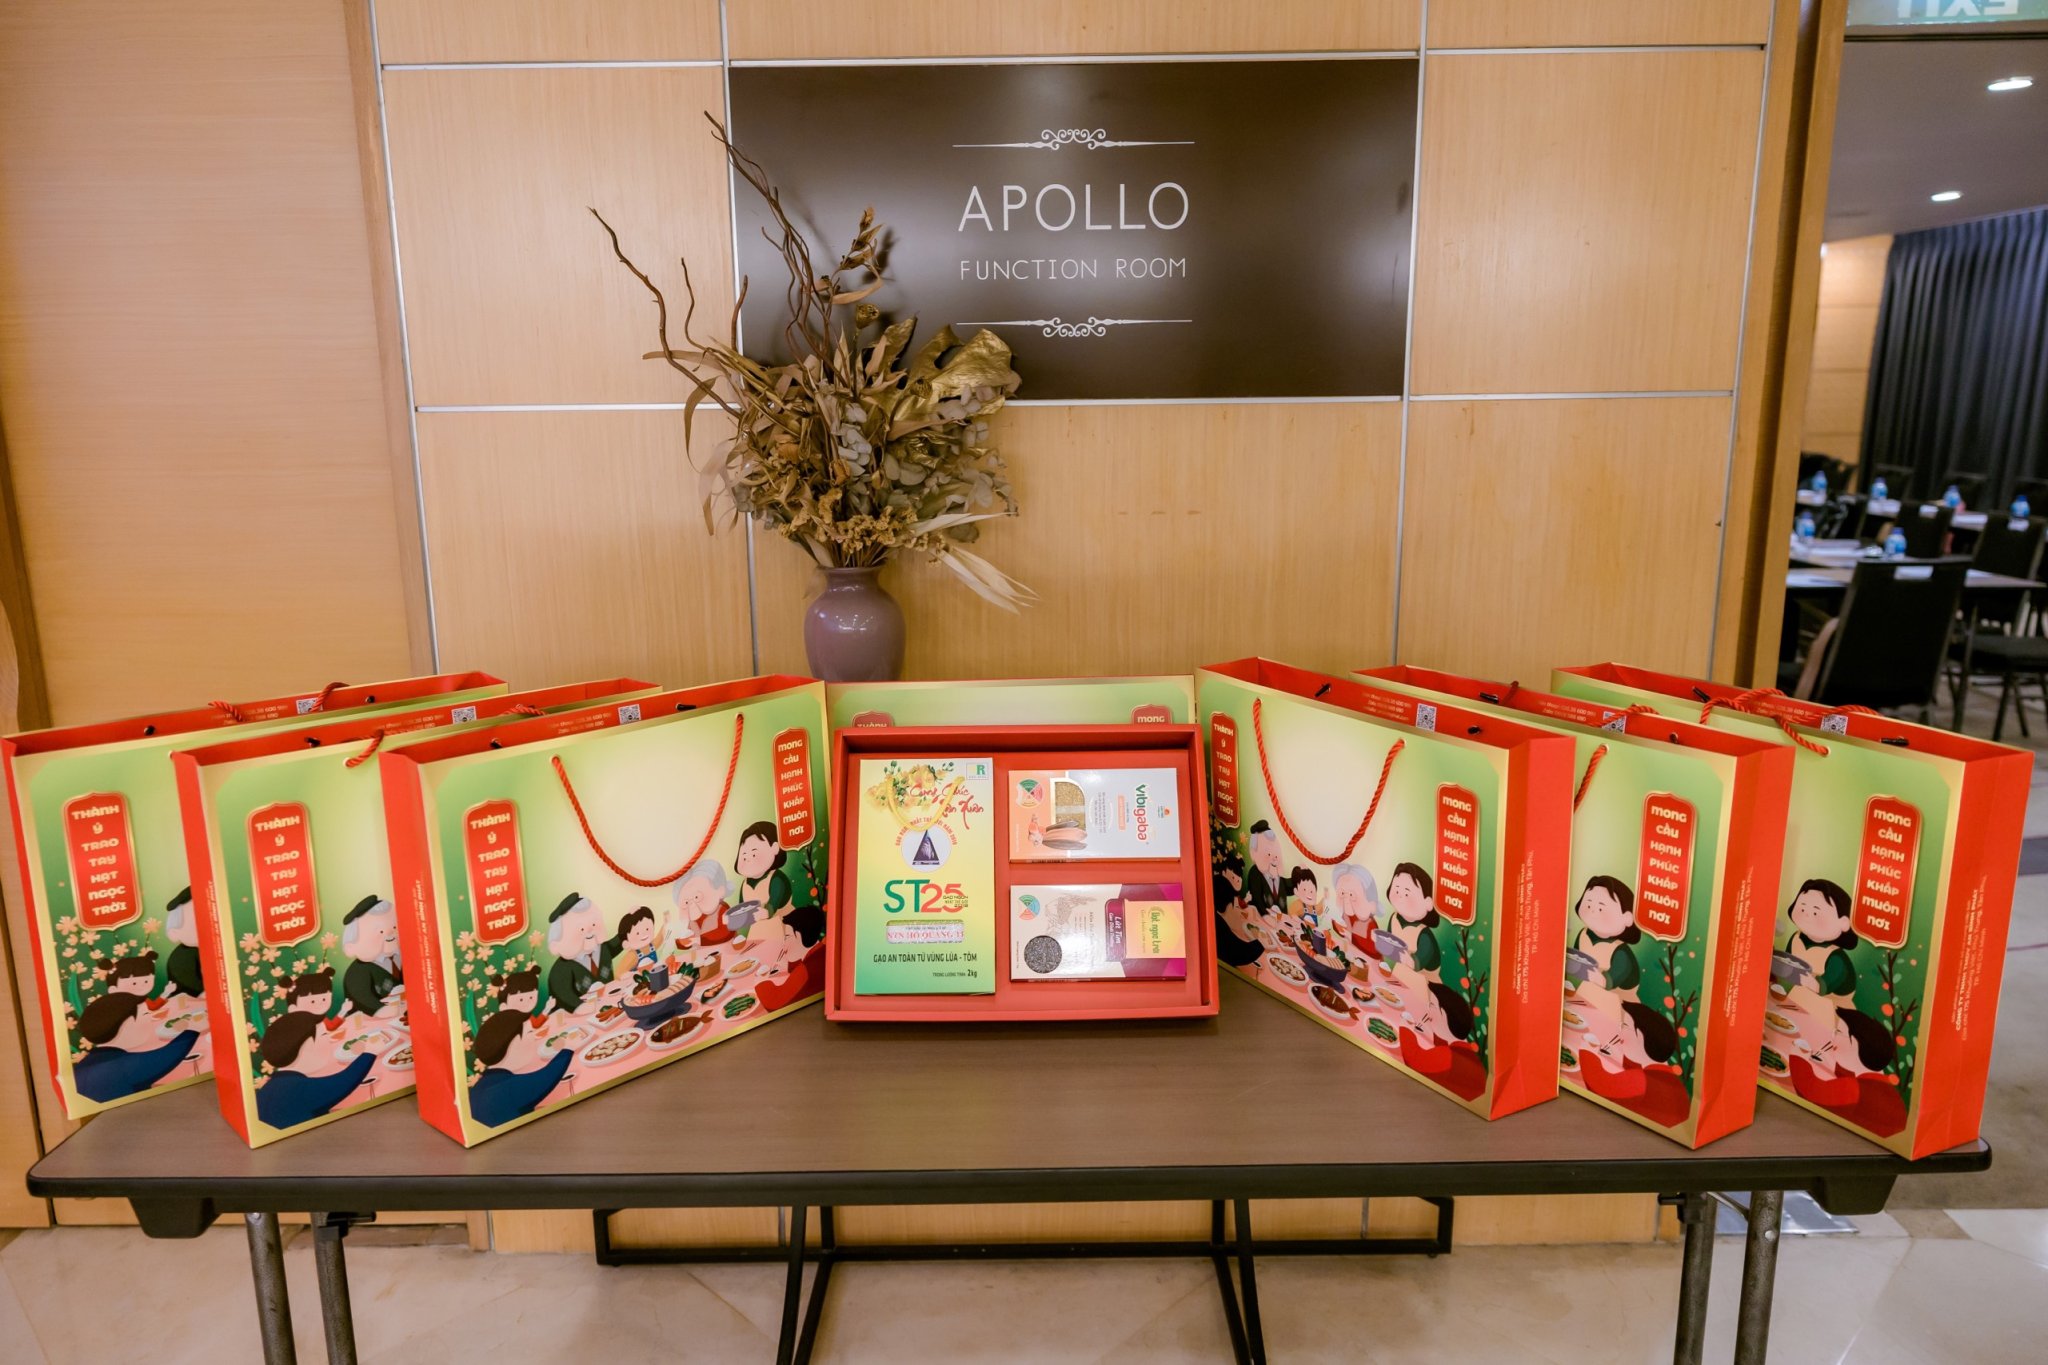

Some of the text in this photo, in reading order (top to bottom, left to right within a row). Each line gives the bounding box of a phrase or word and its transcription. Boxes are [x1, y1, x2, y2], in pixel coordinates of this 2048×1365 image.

[958, 182, 1189, 231] APOLLO
[960, 258, 1186, 280] FUNCTION ROOM
[783, 783, 803, 795] PHÚC
[72, 805, 119, 819] THÀNH
[255, 816, 299, 832] THÀNH
[470, 813, 511, 829] THÀNH
[81, 838, 119, 852] TRAO
[264, 851, 299, 865] TRAO
[478, 848, 510, 862] TRAO
[1444, 846, 1468, 860] PHÚC
[88, 855, 116, 867] TAY
[1649, 858, 1679, 874] PHÚC
[271, 868, 297, 880] TAY
[484, 866, 507, 878] TAY
[1869, 862, 1902, 879] PHÚC
[883, 879, 965, 913] ST25
[888, 954, 897, 962] AN
[898, 952, 916, 962] TOÀN
[927, 952, 944, 962] VÙNG
[968, 969, 978, 978] 2kg
